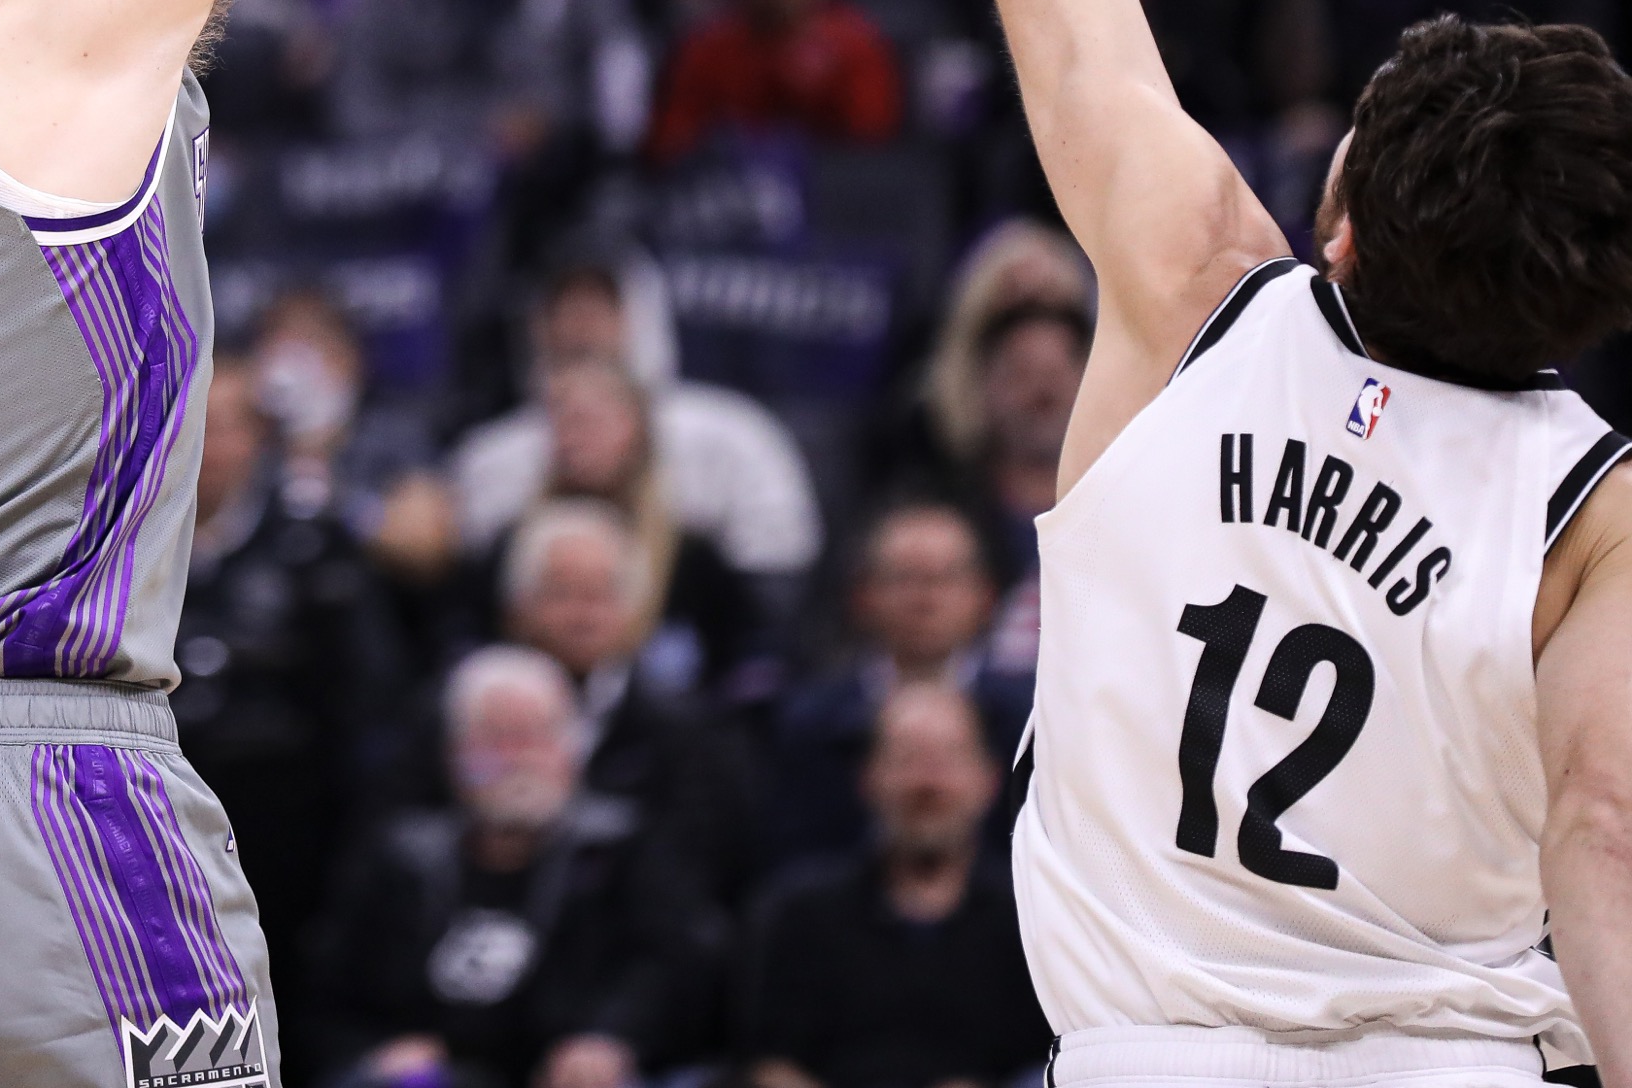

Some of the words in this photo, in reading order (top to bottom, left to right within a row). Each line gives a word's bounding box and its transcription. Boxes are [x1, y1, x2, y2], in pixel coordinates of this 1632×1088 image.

[1347, 419, 1366, 435] NBA
[1220, 432, 1453, 617] HARRIS
[1175, 583, 1376, 891] 12
[138, 1062, 263, 1088] SACRAMENTO
